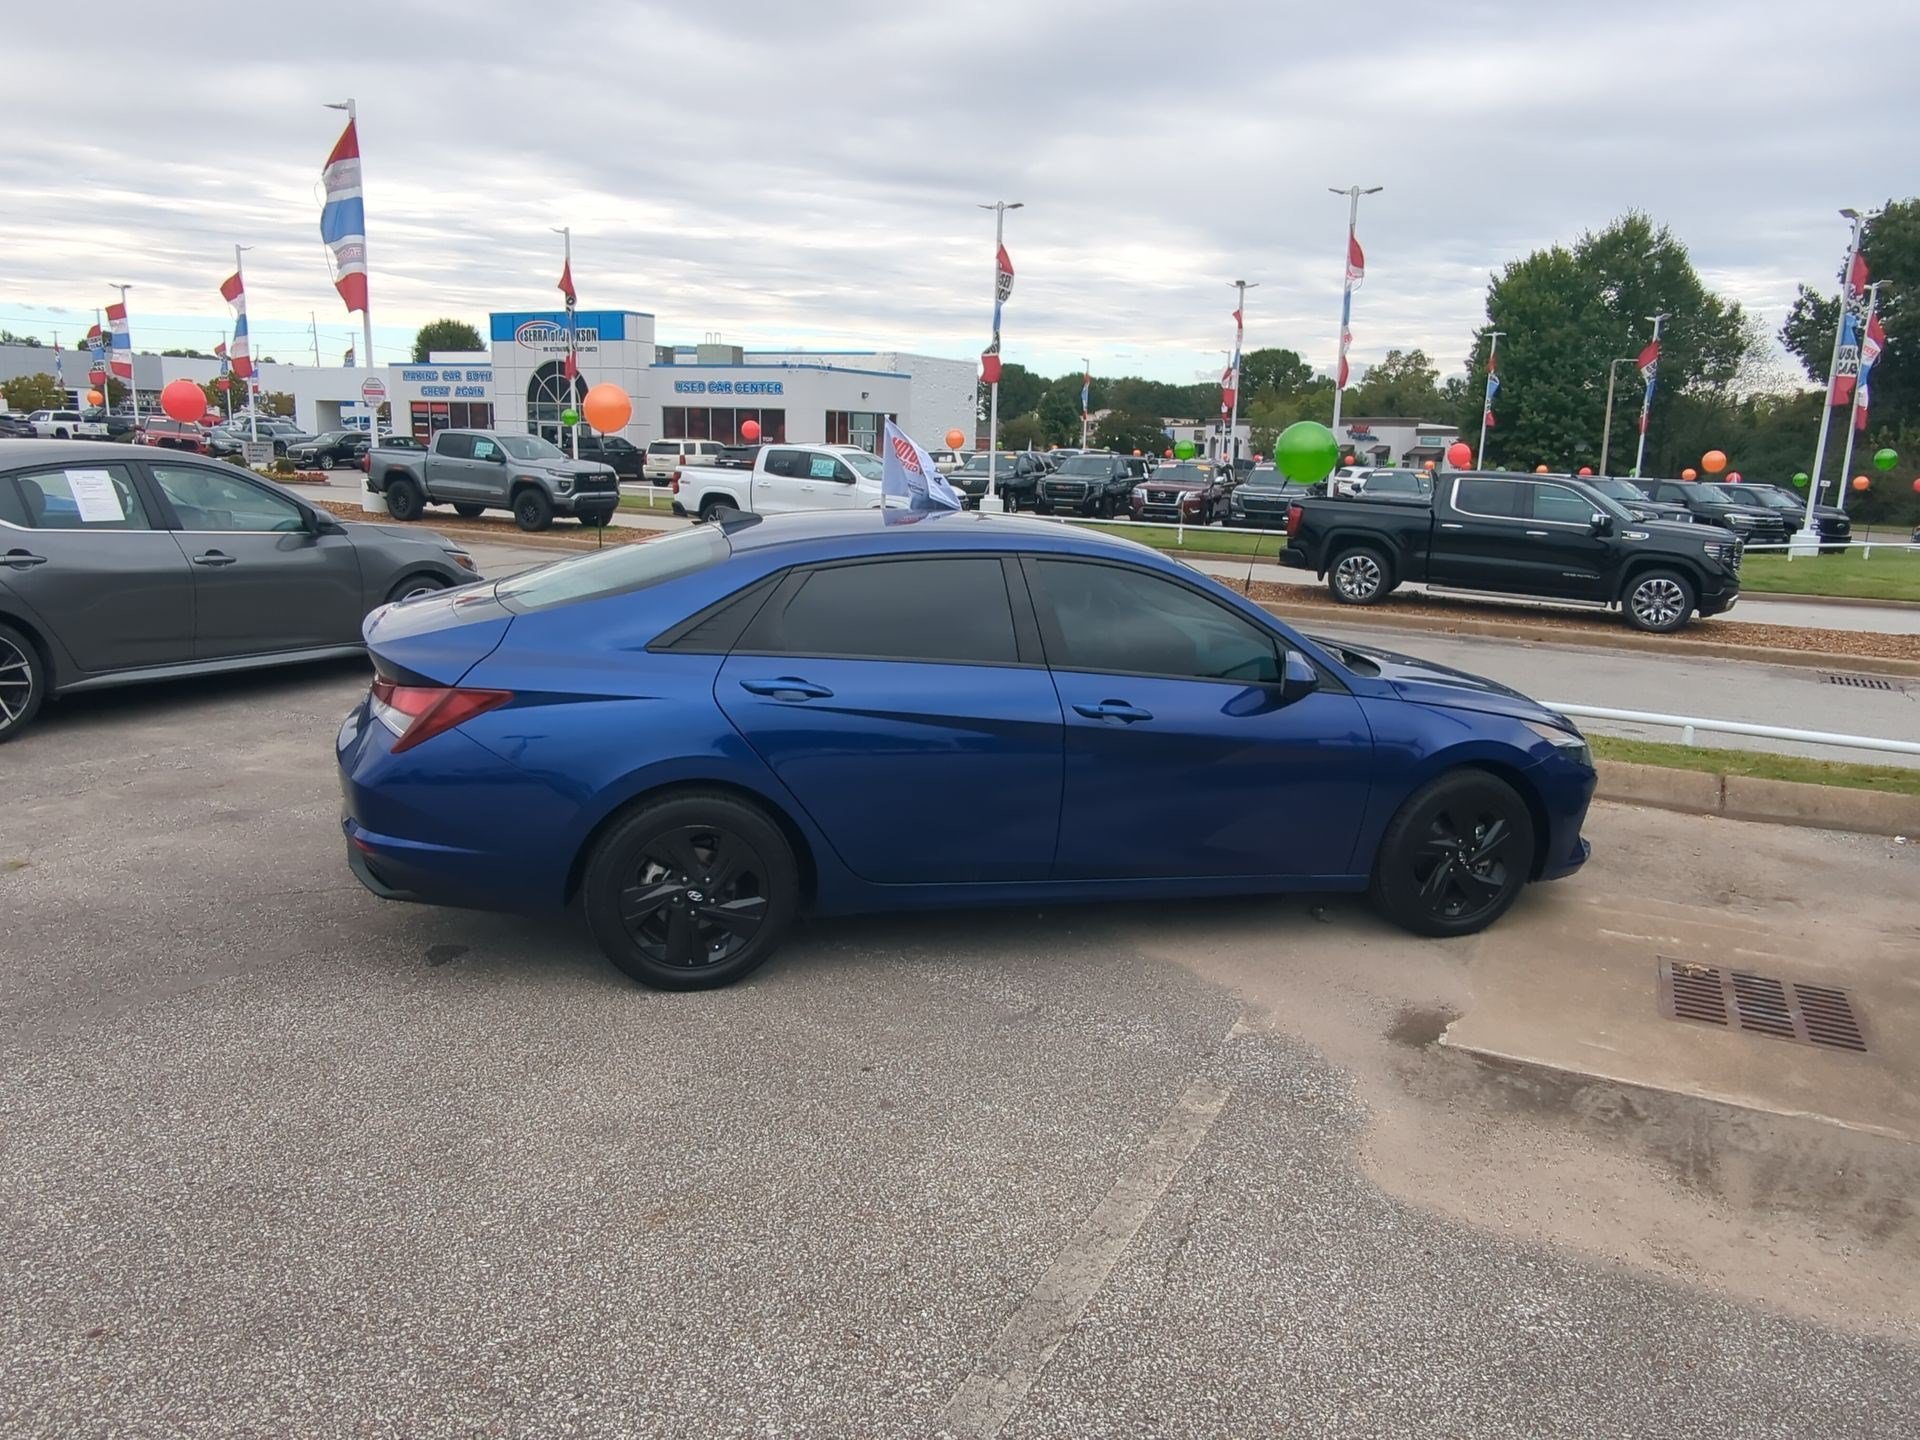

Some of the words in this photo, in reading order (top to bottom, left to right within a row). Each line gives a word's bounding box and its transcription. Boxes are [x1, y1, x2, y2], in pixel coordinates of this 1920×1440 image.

[523, 329, 548, 342] SERRA
[560, 329, 597, 342] JKSON
[442, 370, 462, 382] CAR
[421, 386, 451, 398] GREAT
[455, 386, 486, 398] AGAIN
[674, 380, 706, 393] USED
[708, 381, 733, 394] CAR
[734, 381, 784, 395] CENTER
